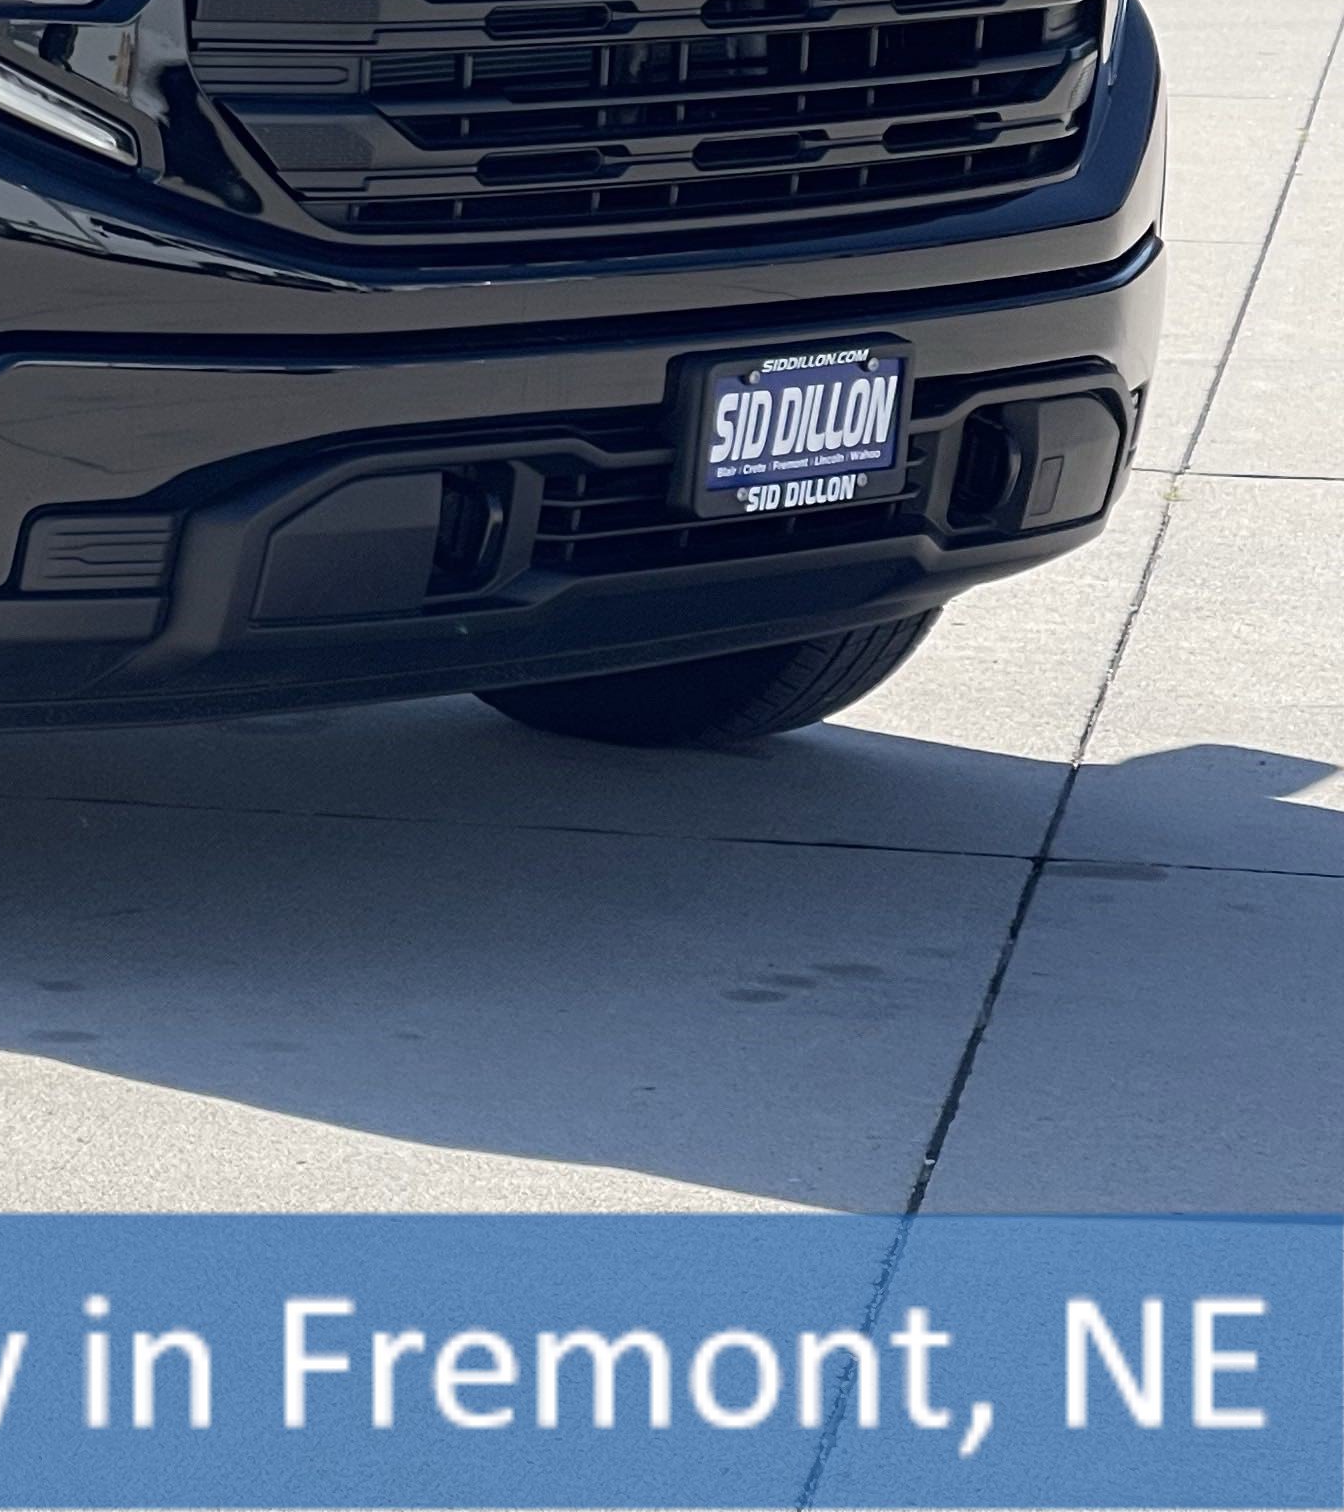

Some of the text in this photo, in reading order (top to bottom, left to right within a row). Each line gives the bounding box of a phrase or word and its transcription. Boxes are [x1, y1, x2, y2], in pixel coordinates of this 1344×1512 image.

[761, 349, 870, 374] SIDDILLON.COM
[709, 375, 899, 464] SID DILLON
[772, 457, 809, 471] Fremont
[814, 453, 845, 466] Lincoln
[745, 474, 857, 513] SID DILLON
